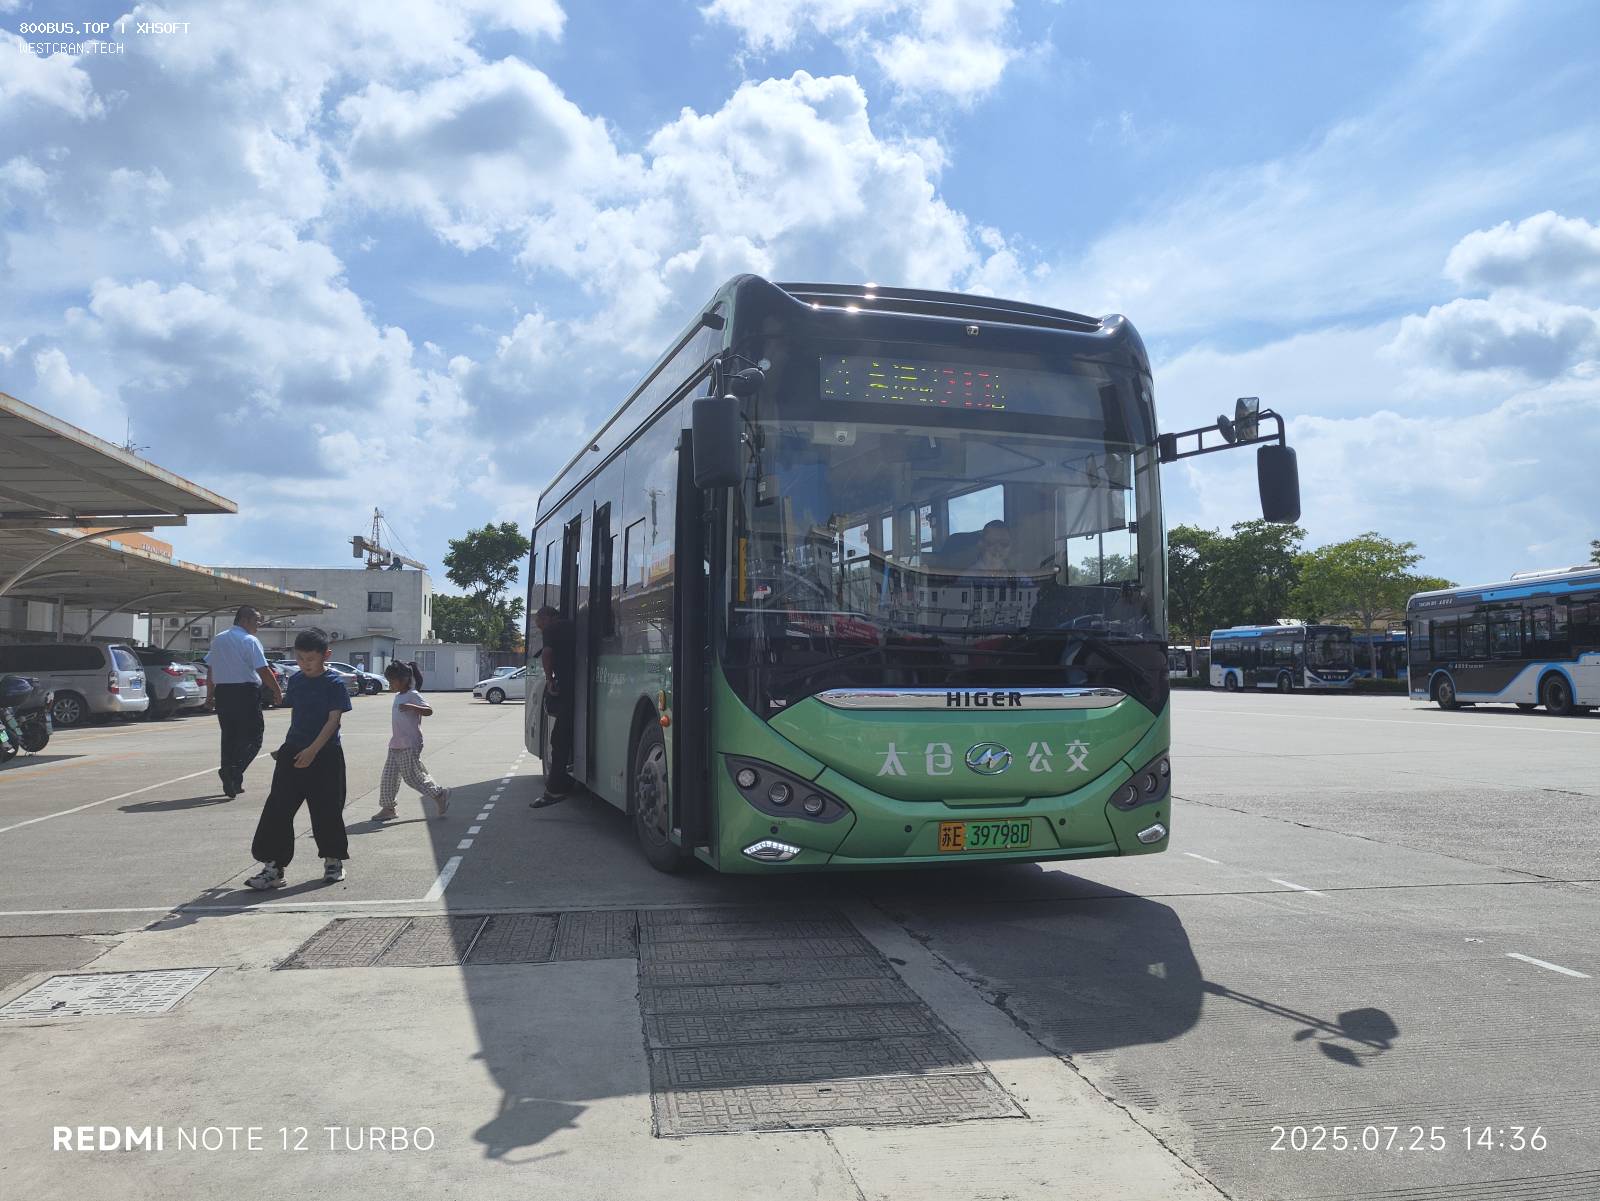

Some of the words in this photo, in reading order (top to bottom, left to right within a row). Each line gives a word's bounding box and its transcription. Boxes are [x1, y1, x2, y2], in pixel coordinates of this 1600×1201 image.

[947, 691, 1022, 707] HIGER
[875, 742, 953, 776] 太仓
[1026, 739, 1091, 773] 公交
